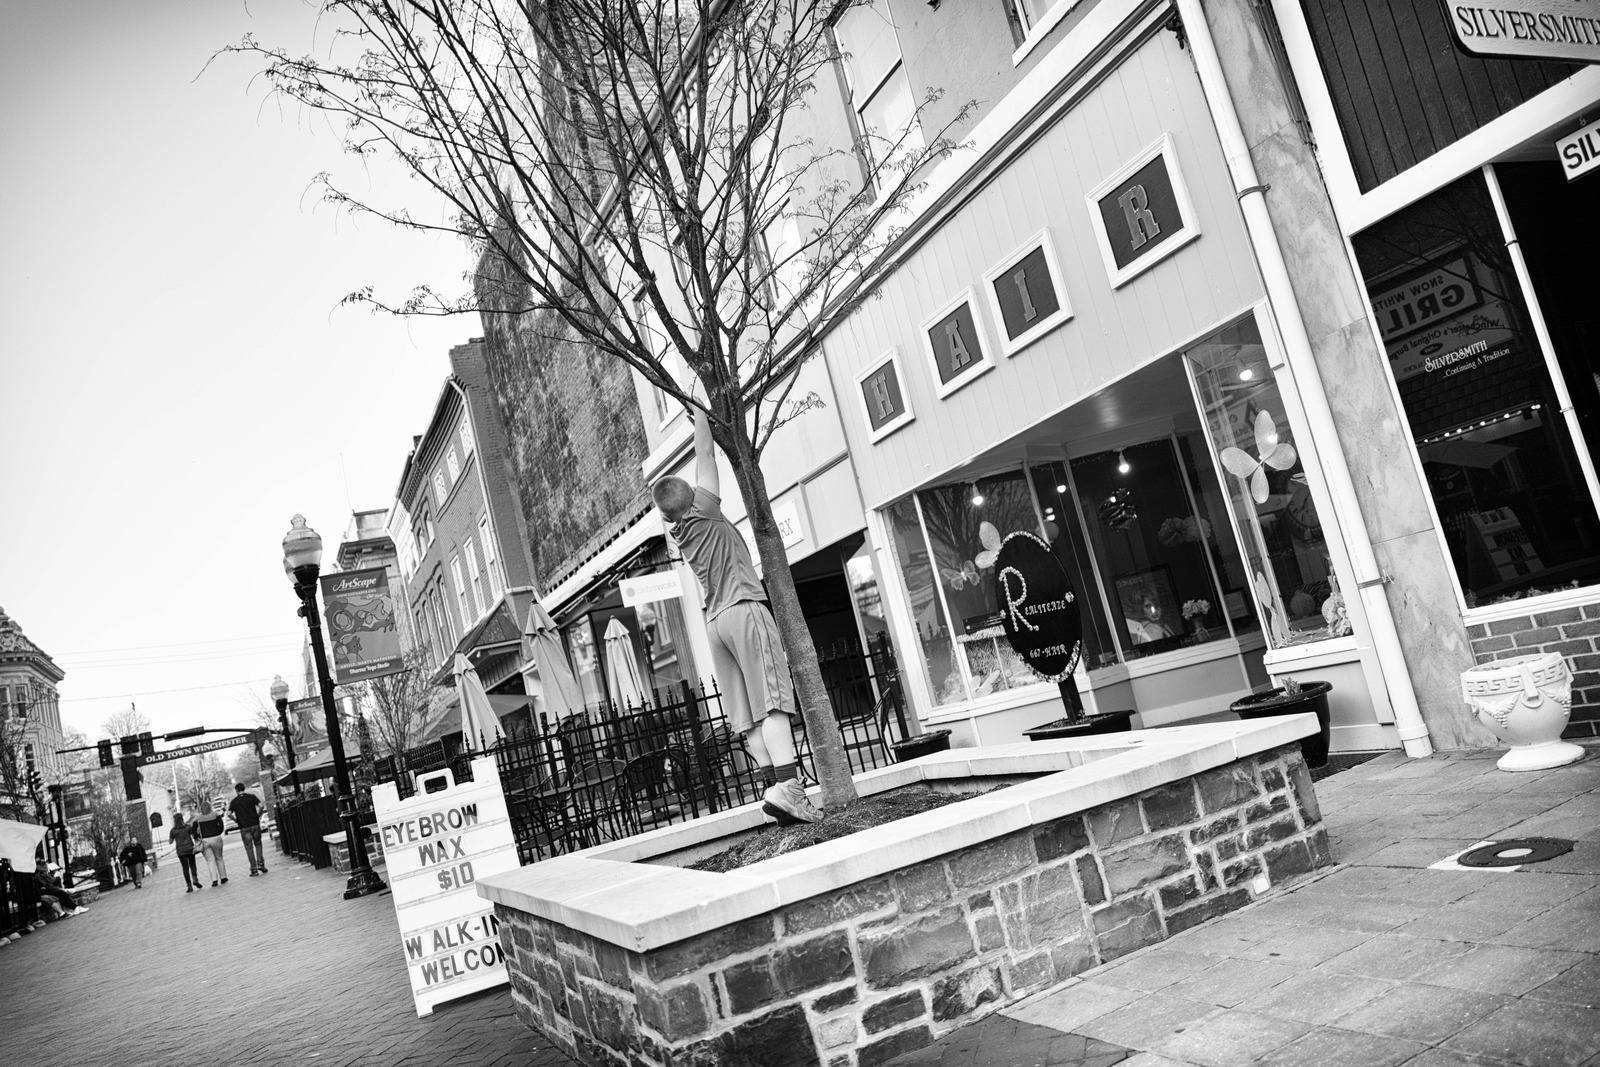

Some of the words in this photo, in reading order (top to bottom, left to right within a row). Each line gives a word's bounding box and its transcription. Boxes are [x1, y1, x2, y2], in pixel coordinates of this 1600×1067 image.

[1563, 128, 1600, 169] SIL
[1425, 340, 1488, 372] SILVERSMITH
[1482, 348, 1510, 362] Tradition
[332, 577, 377, 592] ArtScape
[1029, 644, 1068, 659] 667-HAIR
[145, 754, 165, 763] OLD
[166, 747, 192, 758] TOWN
[193, 736, 248, 754] WINCHESTER
[381, 803, 478, 848] EYEBROW
[418, 835, 466, 867] WAX
[437, 861, 475, 890] $10
